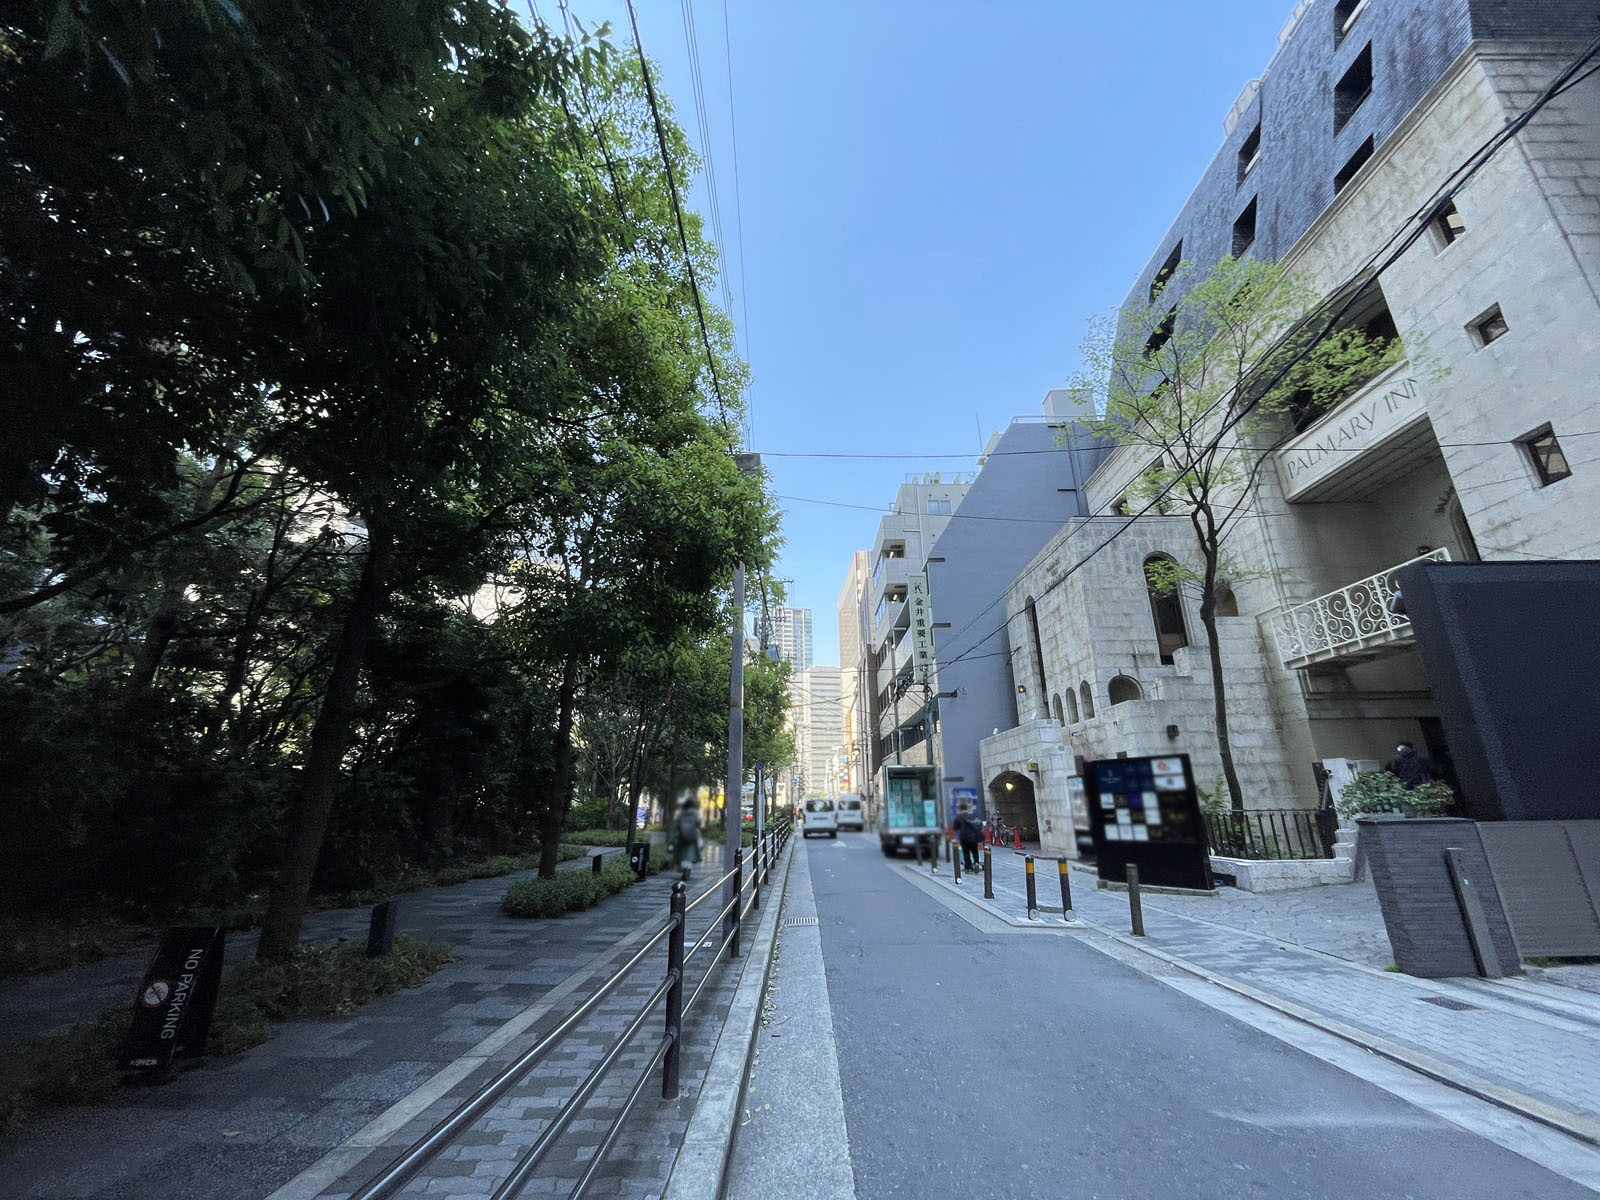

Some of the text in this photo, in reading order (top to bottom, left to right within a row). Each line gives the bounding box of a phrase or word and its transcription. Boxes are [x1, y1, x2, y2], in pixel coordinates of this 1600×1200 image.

[1287, 402, 1377, 480] PALMARY
[160, 949, 204, 1040] NO PARKING
